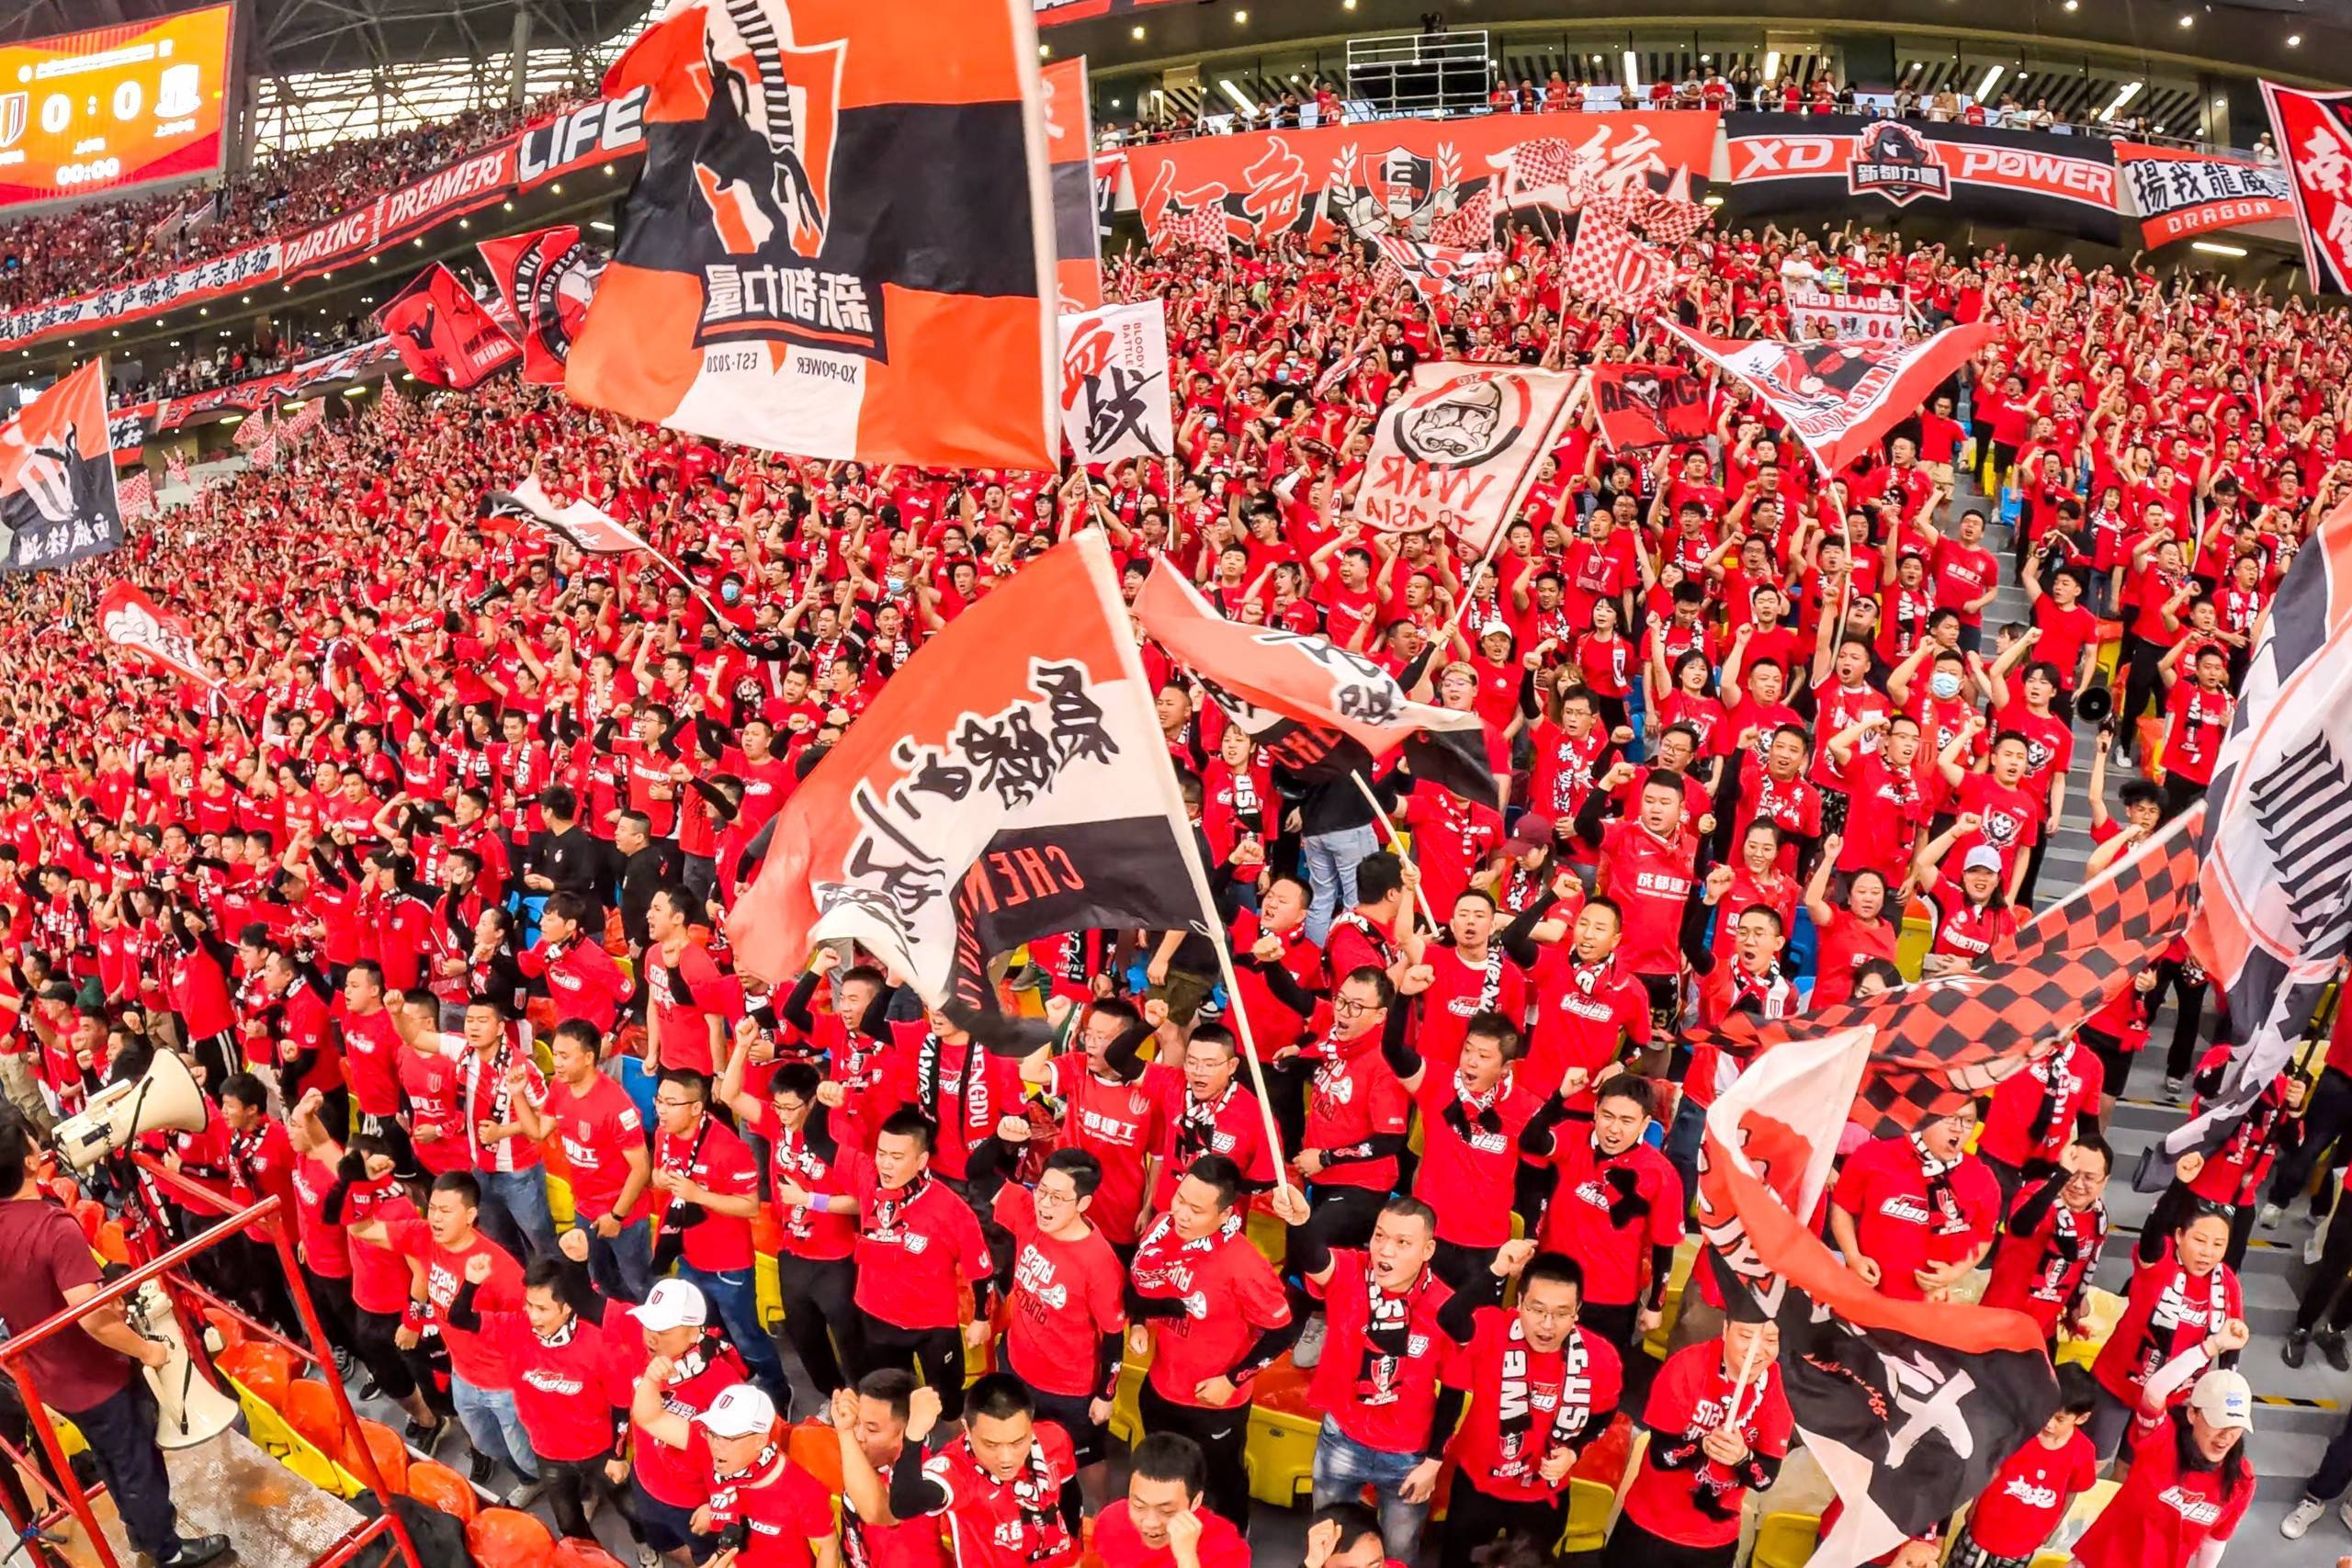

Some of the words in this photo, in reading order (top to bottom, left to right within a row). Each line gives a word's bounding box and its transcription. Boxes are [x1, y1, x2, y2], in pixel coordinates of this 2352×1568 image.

[41, 93, 71, 133] 0
[113, 81, 141, 120] 0
[519, 87, 643, 182] LIFE
[56, 157, 119, 186] 00:00
[1737, 139, 1833, 178] XD
[1857, 164, 1941, 188] 新都力量
[1958, 147, 2112, 205] POWER
[285, 212, 366, 269] DARING
[388, 152, 507, 227] DREAMERS
[2166, 201, 2272, 234] DRAGON
[189, 245, 271, 289] 斗志昂扬
[1796, 292, 1832, 308] RED
[1835, 295, 1903, 313] BLADES
[1123, 322, 1134, 367] BATTLE
[1133, 321, 1145, 369] BLOODY
[1868, 319, 1894, 339] 06
[918, 1032, 936, 1105] CURVA
[1080, 1108, 1139, 1141] 都建工
